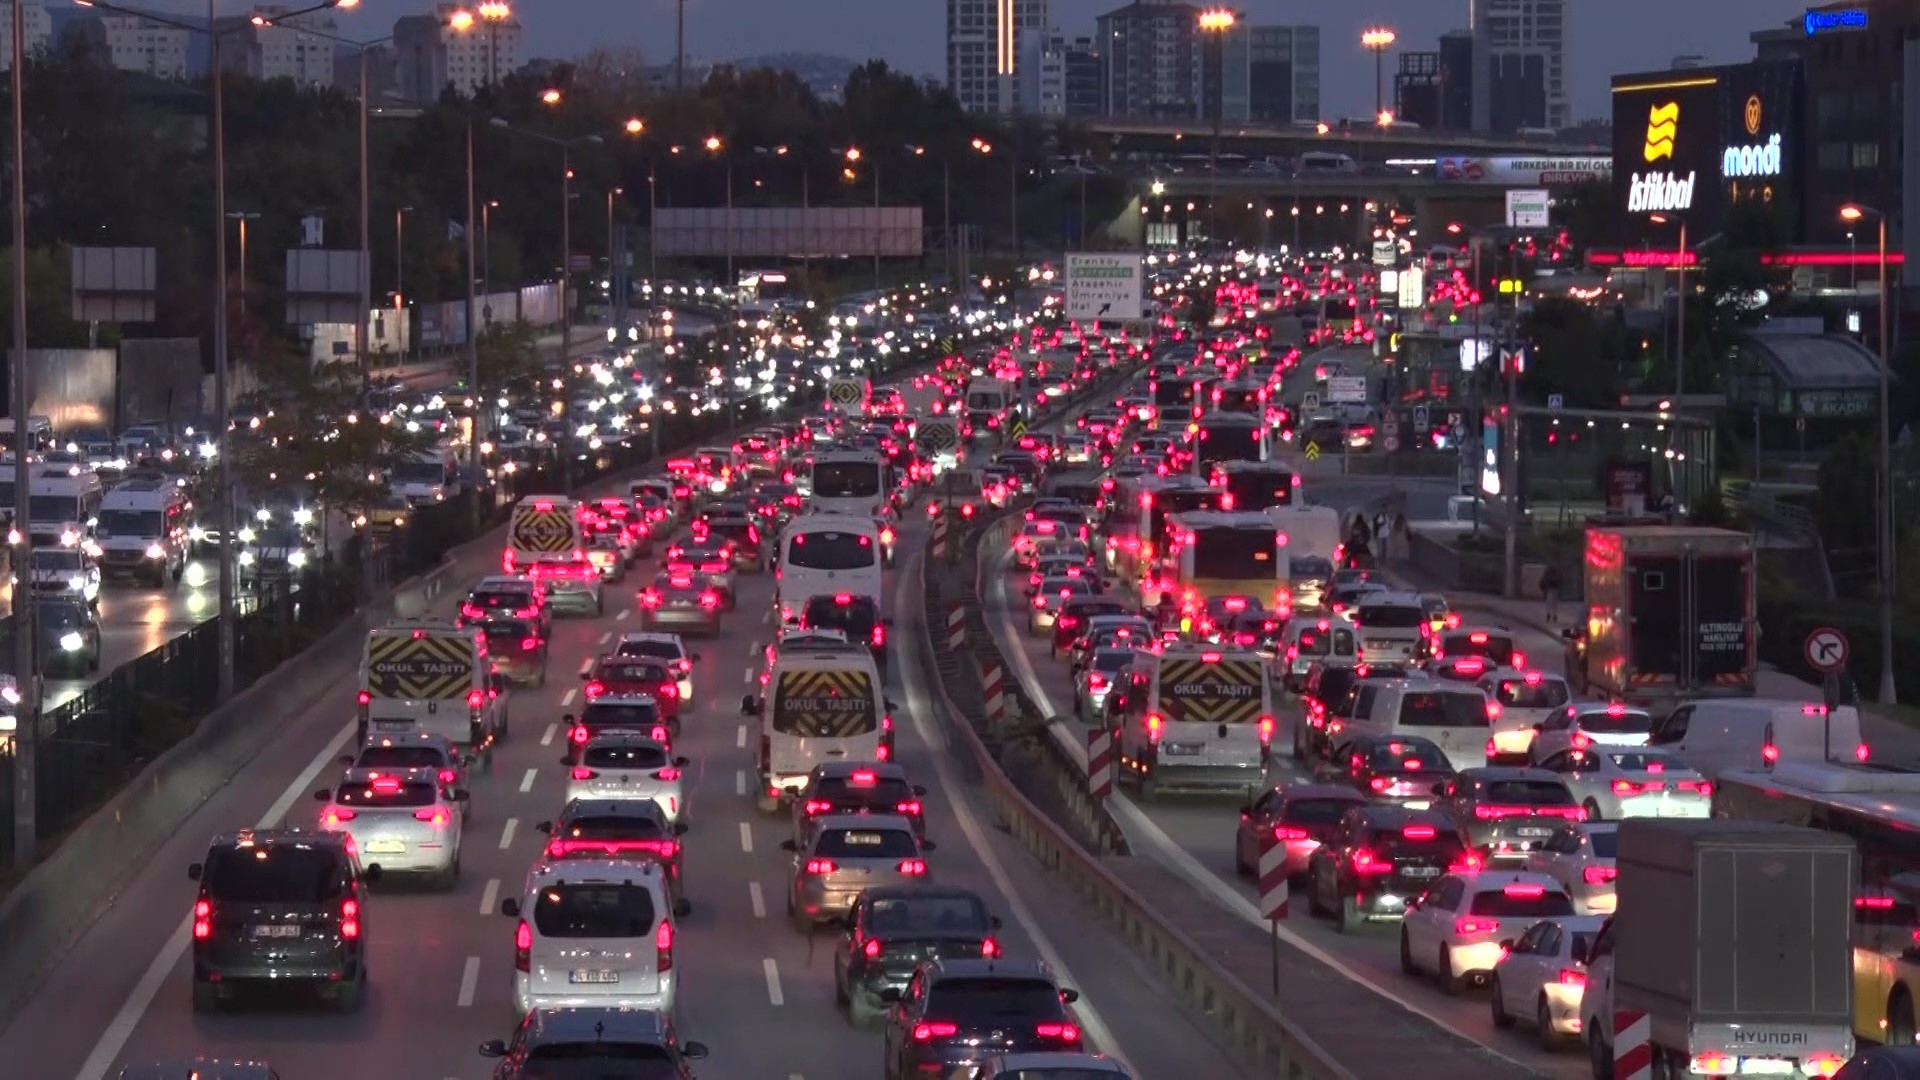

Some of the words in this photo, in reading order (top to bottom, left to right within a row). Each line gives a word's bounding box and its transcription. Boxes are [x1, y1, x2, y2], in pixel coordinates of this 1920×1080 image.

[1724, 133, 1781, 176] mondi
[1559, 159, 1574, 170] BİR
[1628, 171, 1695, 212] istikbal
[377, 663, 416, 672] OKUL
[423, 663, 465, 674] TAŞITI
[1174, 685, 1205, 694] OKUL
[1215, 685, 1252, 696] TAŞITI
[784, 699, 820, 710] OKUL
[825, 699, 866, 712] TAŞITI
[1735, 1031, 1808, 1045] HYUNDAI
